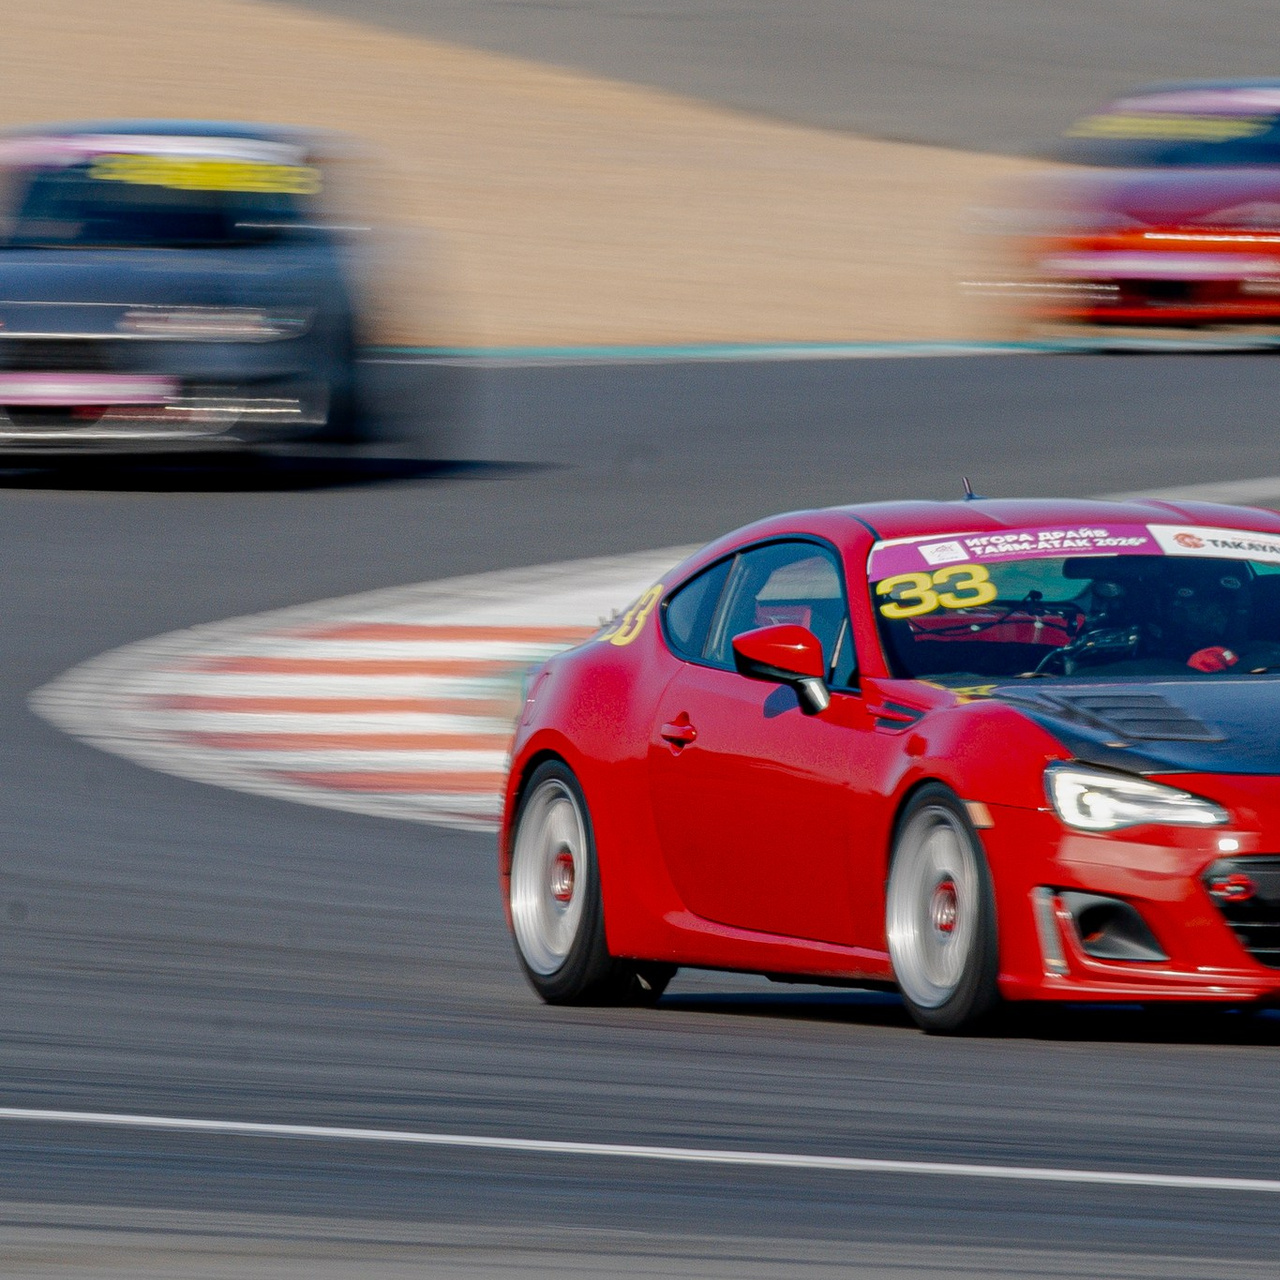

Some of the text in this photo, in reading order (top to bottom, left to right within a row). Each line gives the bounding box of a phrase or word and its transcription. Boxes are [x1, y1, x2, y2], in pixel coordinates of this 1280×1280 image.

[964, 527, 1108, 547] ИГОРА ДРАЙВ
[970, 538, 1092, 555] ТАЙМ-АТАК
[876, 563, 997, 619] 33
